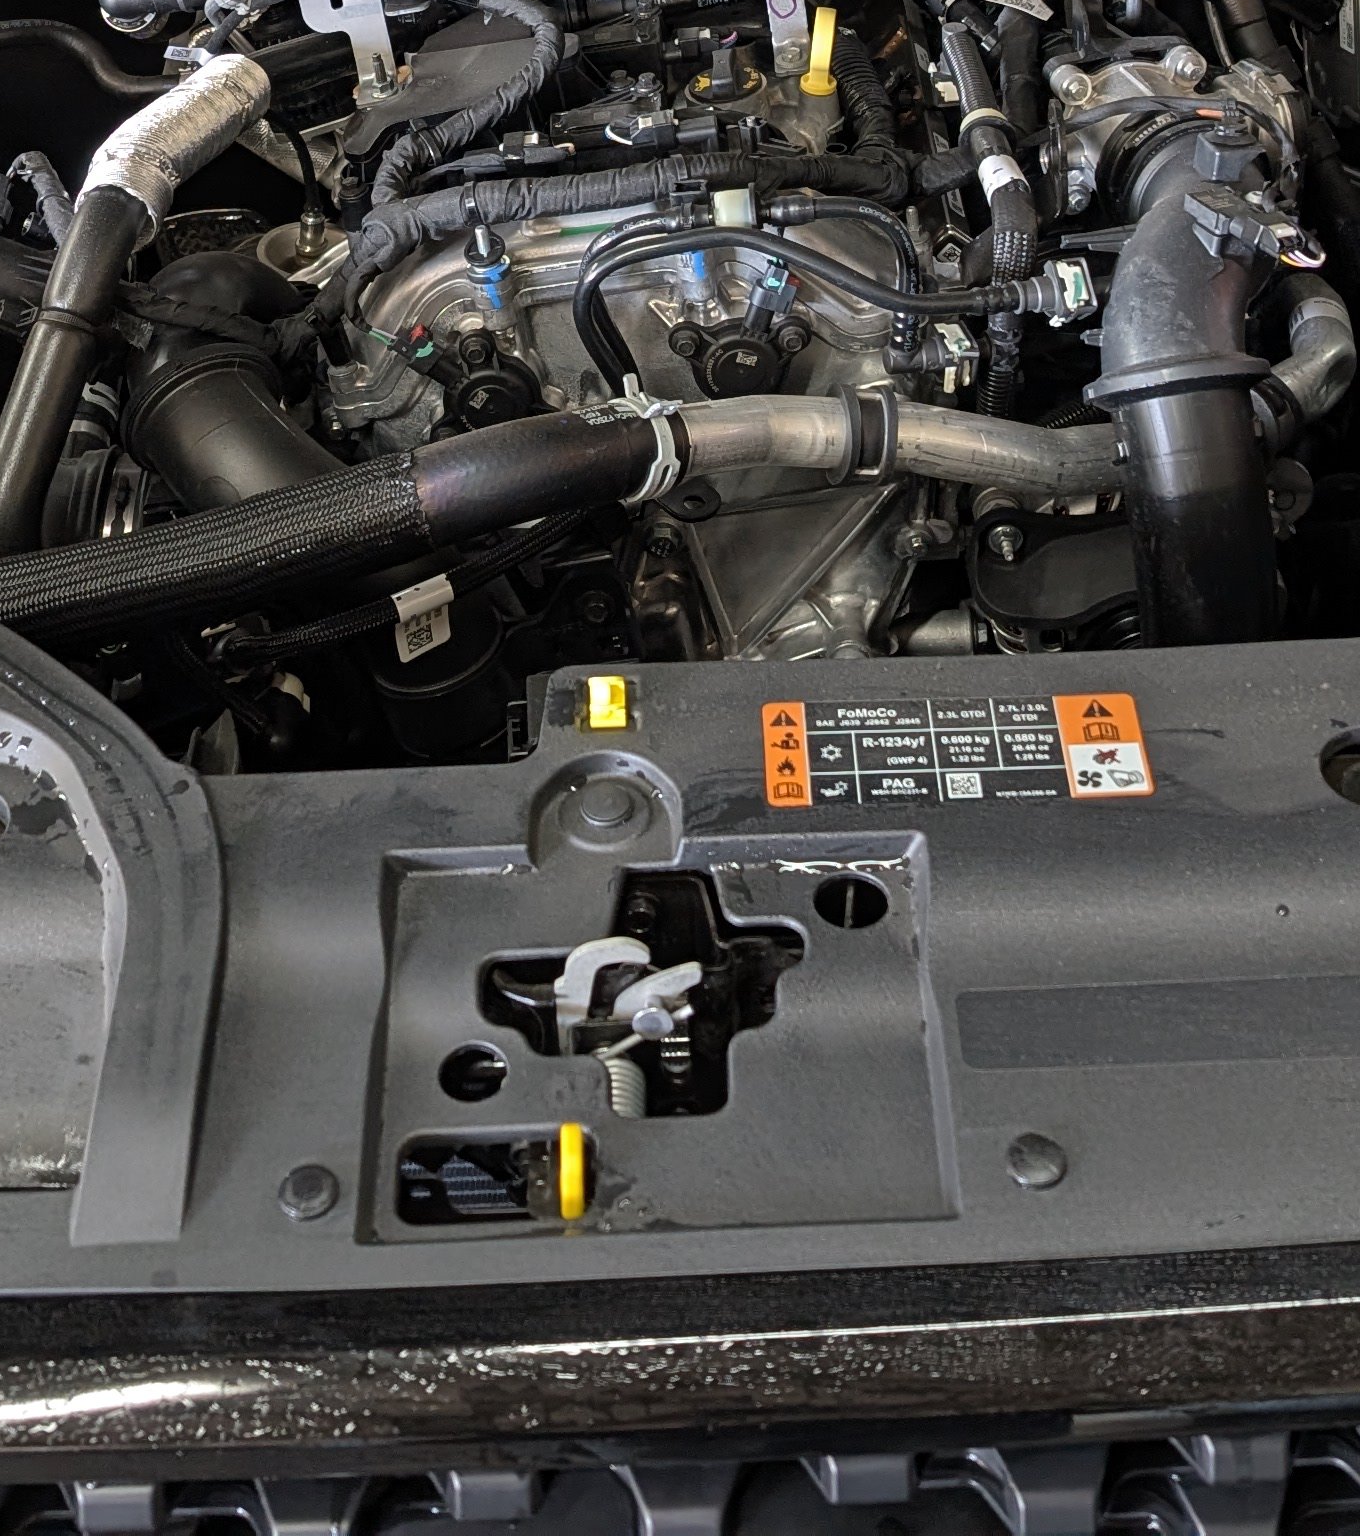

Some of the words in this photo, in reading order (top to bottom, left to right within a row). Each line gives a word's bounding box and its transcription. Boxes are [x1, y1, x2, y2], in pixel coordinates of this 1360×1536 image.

[837, 707, 897, 718] FoMoCo
[862, 735, 925, 749] R-1234yf
[940, 735, 973, 745] 0.600
[974, 734, 990, 745] kg
[1038, 733, 1054, 744] kg
[886, 755, 916, 766] (GWP
[881, 777, 916, 789] PAG
